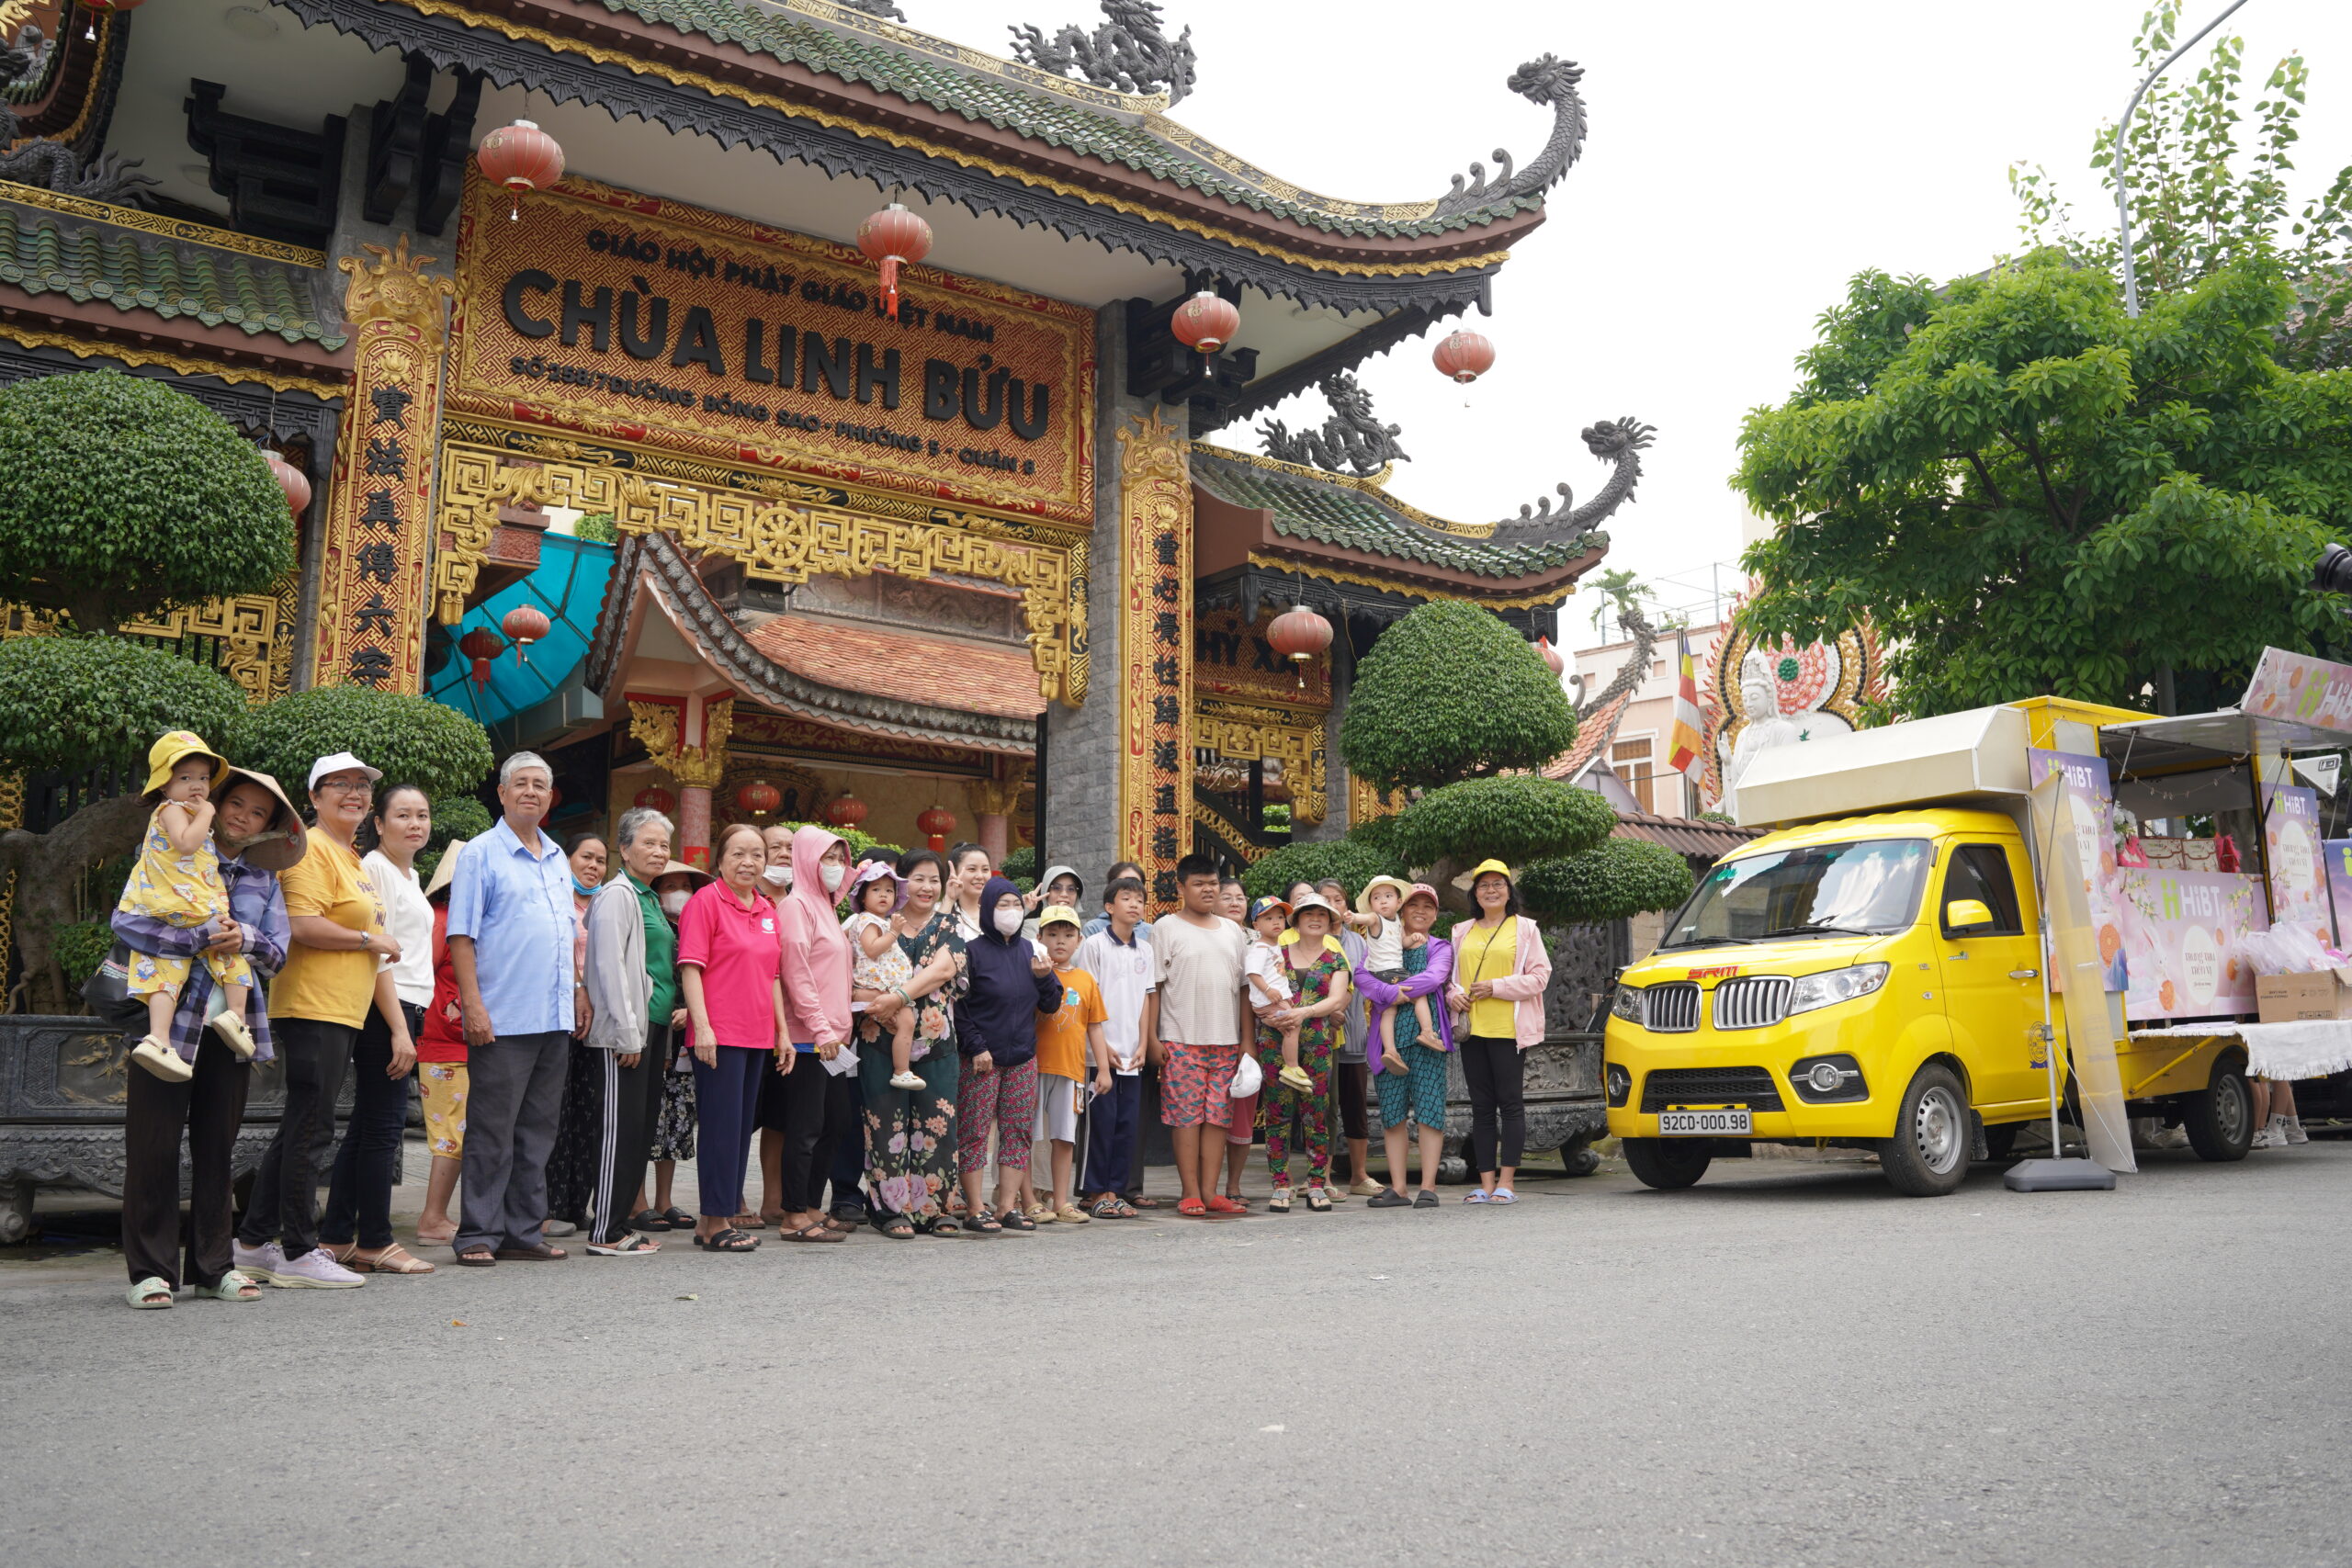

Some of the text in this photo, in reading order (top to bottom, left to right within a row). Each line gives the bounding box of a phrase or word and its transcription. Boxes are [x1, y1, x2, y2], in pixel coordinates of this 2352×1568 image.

[587, 230, 995, 344] GIÁO HỘI PHẬT GIÁO VỆT NAM
[503, 268, 1049, 441] CHÙA LINH BỬU
[511, 355, 548, 378] SỐ
[777, 409, 821, 432] SAO
[928, 440, 941, 457] 5
[958, 446, 1018, 472] QUẬN
[1023, 458, 1036, 475] 8
[2062, 763, 2093, 789] HiBT
[2283, 795, 2306, 816] HiBT
[2179, 885, 2221, 917] HiBT
[1687, 965, 1739, 980] SRM
[1662, 1114, 1747, 1131] 92CD-000.98
